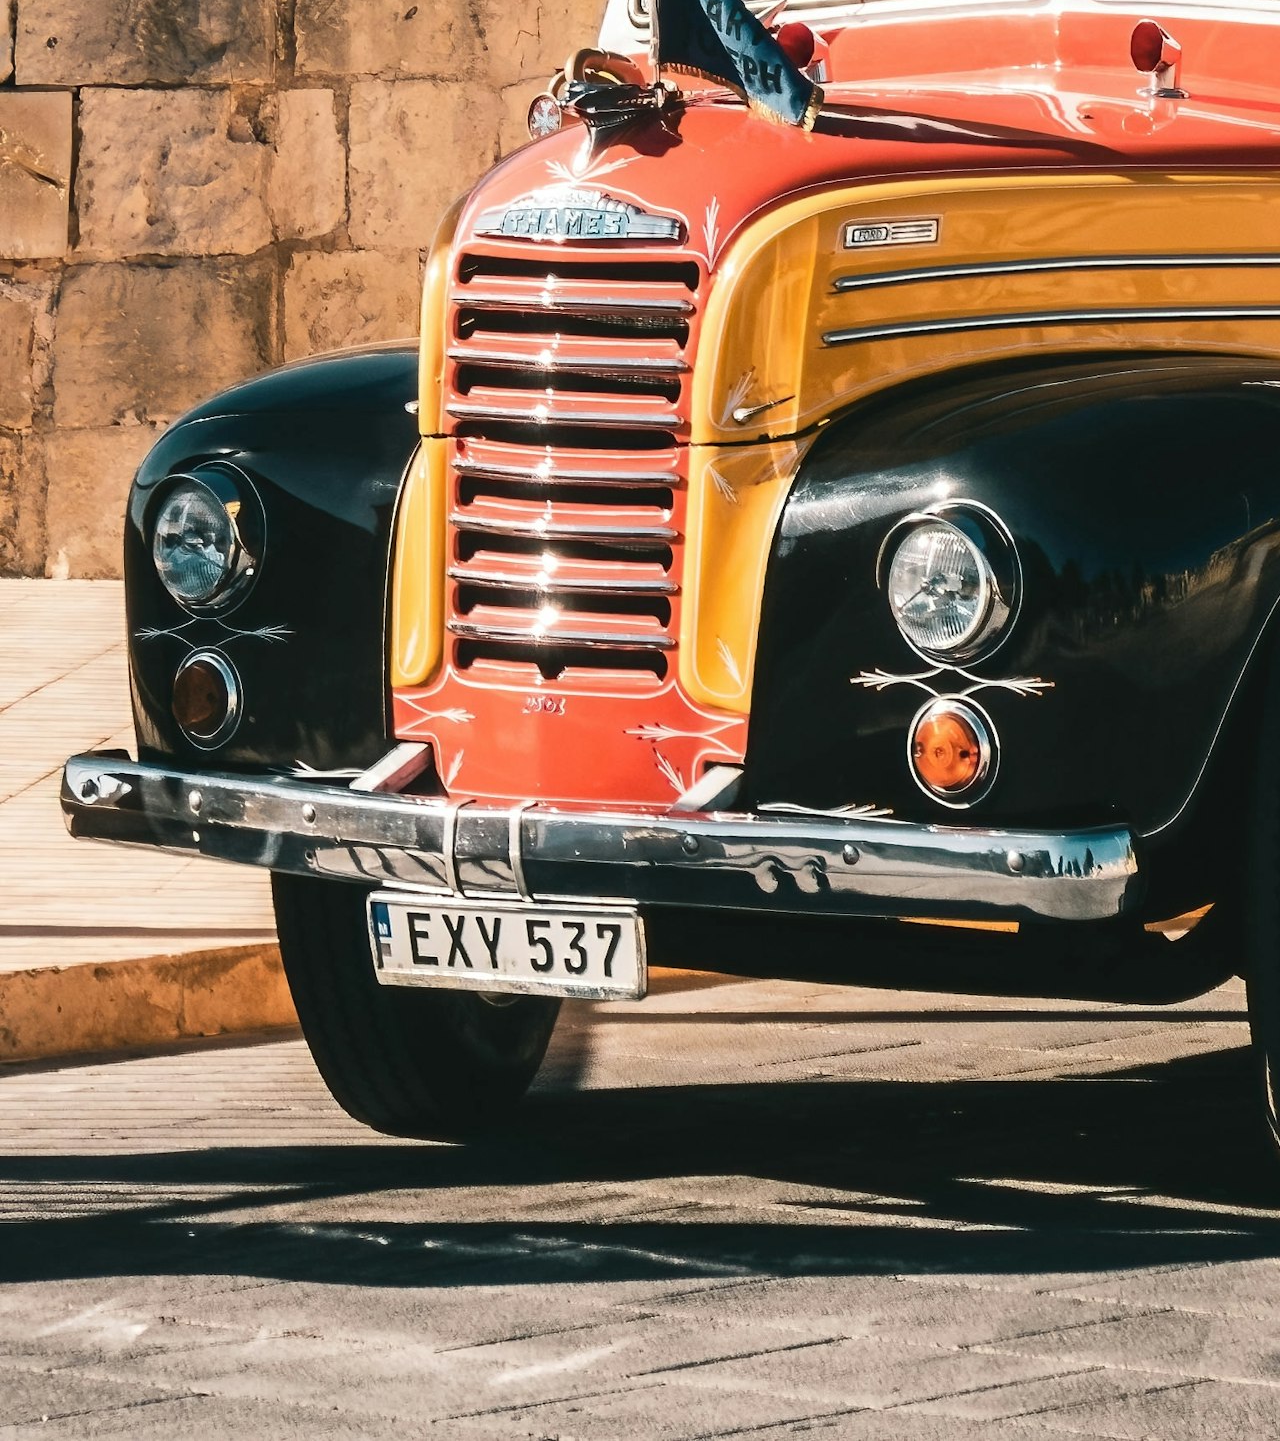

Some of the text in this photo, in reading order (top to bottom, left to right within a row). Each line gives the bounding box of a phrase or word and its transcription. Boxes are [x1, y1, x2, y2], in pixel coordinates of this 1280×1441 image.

[509, 209, 623, 235] THAMES
[858, 229, 883, 240] FORD
[378, 911, 622, 978] M EXY 537
